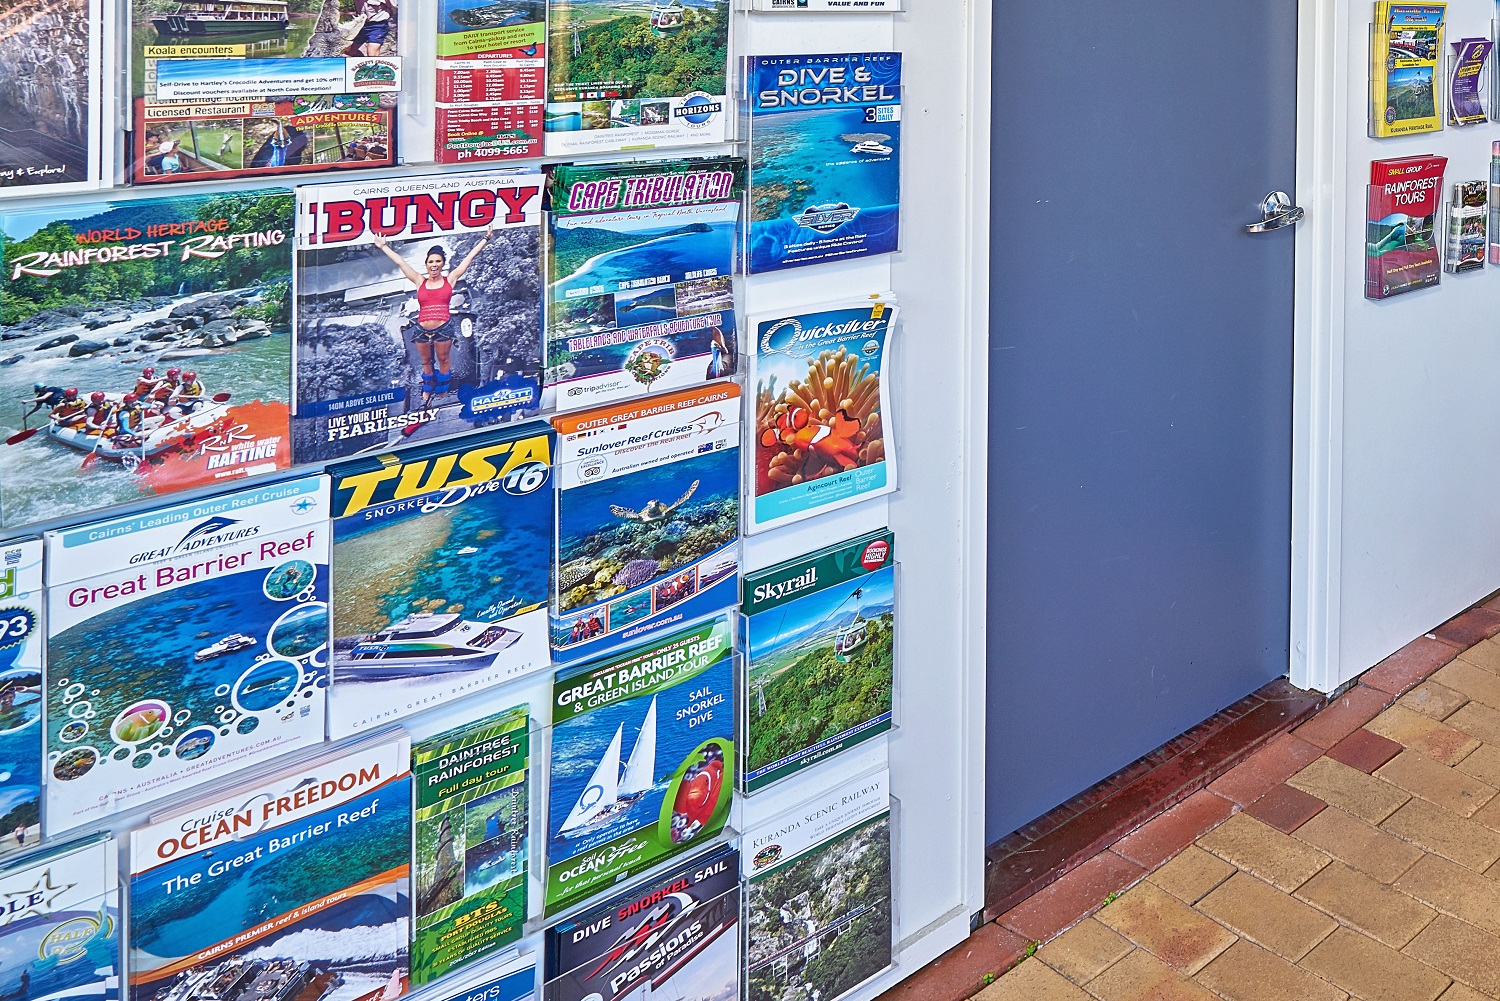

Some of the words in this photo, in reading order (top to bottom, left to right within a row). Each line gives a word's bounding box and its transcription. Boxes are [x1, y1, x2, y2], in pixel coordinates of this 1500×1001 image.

[148, 46, 177, 55] Koala
[180, 45, 233, 55] encounters
[777, 68, 841, 87] DIVE
[851, 67, 872, 83] &
[148, 107, 191, 117] Licensed
[195, 104, 245, 115] Restaurant
[675, 102, 721, 116] HORIZONS
[758, 84, 895, 108] SNORKEL
[458, 149, 472, 160] ph
[474, 147, 501, 157] 4099
[503, 145, 529, 155] 5665
[1406, 165, 1422, 174] GROUP
[569, 179, 621, 211] CAPE
[627, 172, 732, 204] TRIBULATION
[1385, 177, 1439, 195] RAINFOREST
[1395, 191, 1425, 207] TOURS
[76, 226, 140, 245] WORLD
[146, 218, 229, 239] HERITAGE
[324, 186, 540, 244] BUNGY
[10, 240, 175, 281] RAINFOREST
[181, 229, 286, 262] RAFTING
[328, 408, 440, 442] FEARLESSLY
[329, 415, 347, 428] LIVE
[348, 412, 369, 425] YOUR
[371, 408, 388, 421] LIFE
[577, 436, 627, 457] Sunlover
[628, 431, 652, 447] Reef
[654, 422, 693, 439] Cruises
[338, 435, 550, 517] TUSA
[68, 574, 147, 609] Great
[156, 549, 249, 588] Barrier
[259, 530, 316, 562] Reef
[753, 568, 818, 605] Skyrail
[557, 674, 615, 707] GREAT
[618, 647, 686, 691] BARRIER
[687, 634, 723, 662] REEF
[675, 694, 725, 722] SNORKEL
[688, 686, 713, 702] SAIL
[688, 710, 714, 728] DIVE
[428, 743, 520, 787] RAINFOREST
[438, 735, 511, 770] DAINTREE
[157, 809, 253, 860] OCEAN
[263, 763, 381, 821] FREEDOM
[752, 822, 801, 850] KURANDA
[803, 801, 839, 828] SCENIC
[841, 781, 881, 808] RAILWAY
[572, 918, 611, 944] DIVE
[617, 877, 690, 920] SNORKEL
[694, 860, 727, 884] SAIL
[609, 921, 701, 996] Passions
